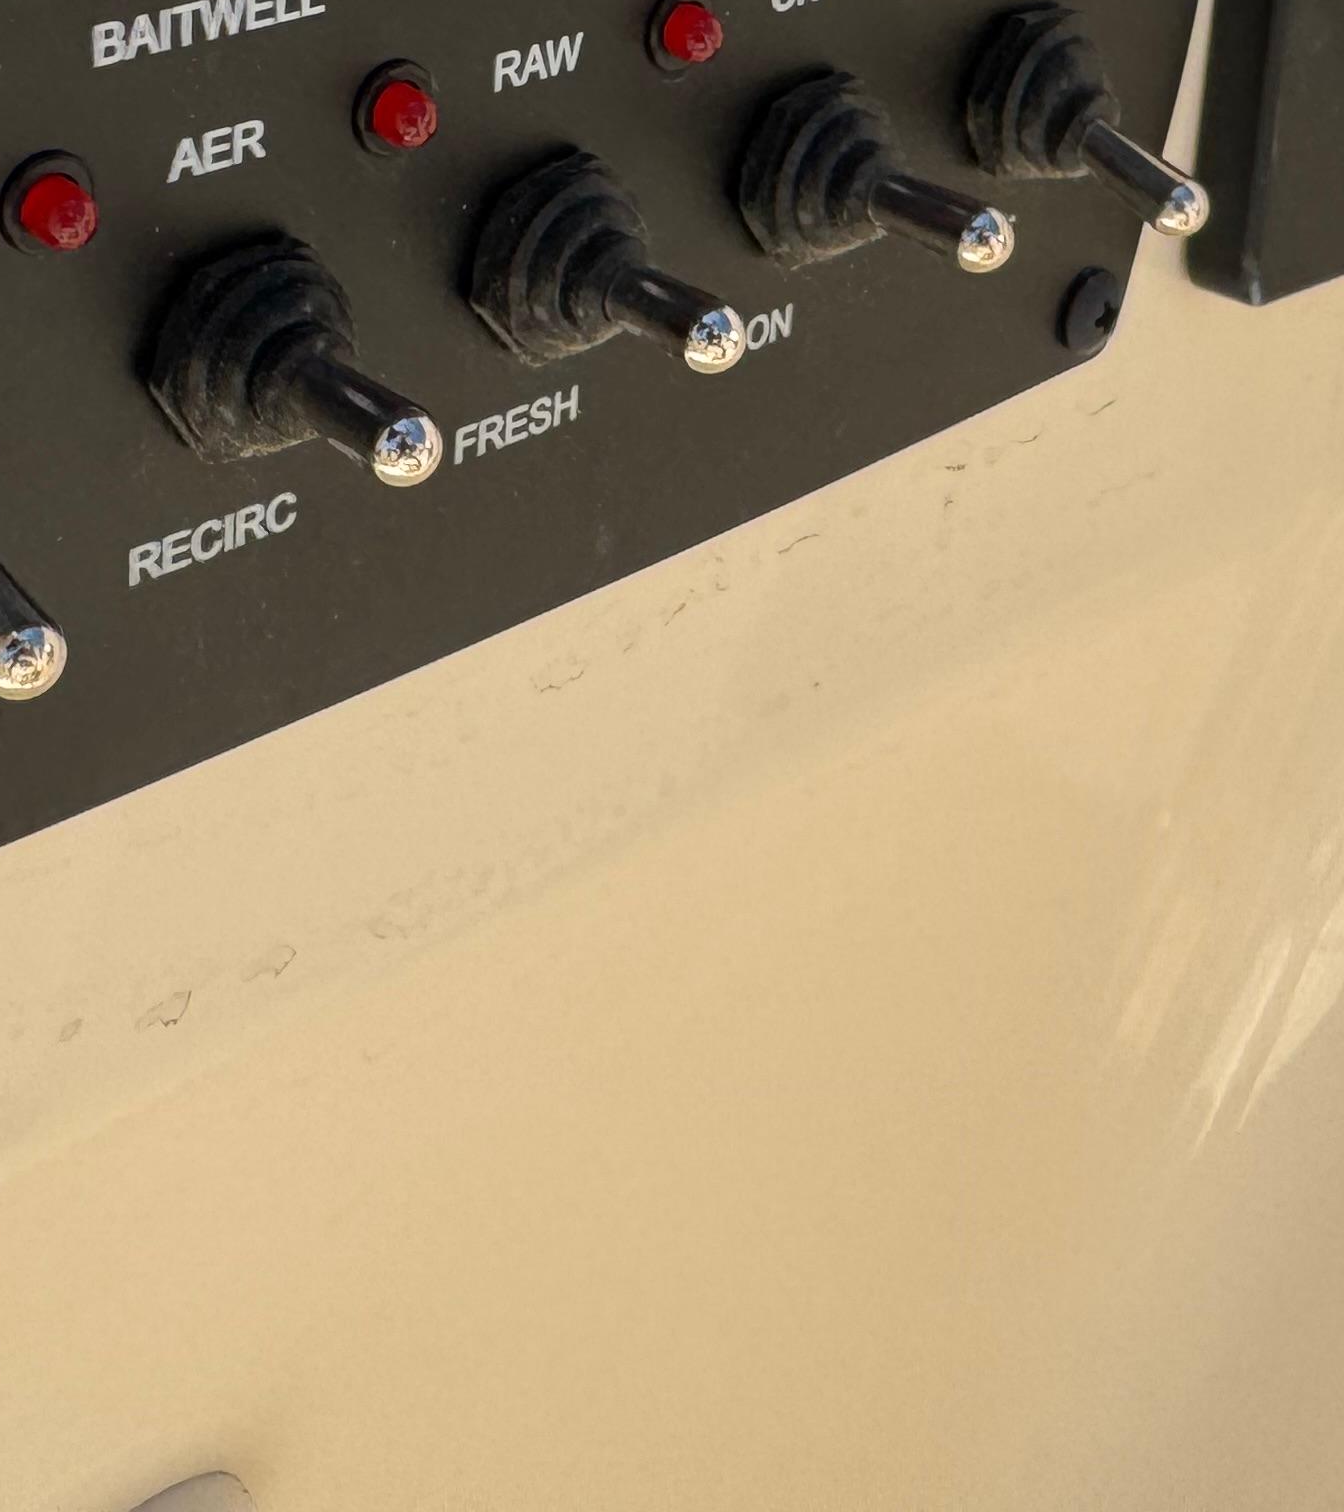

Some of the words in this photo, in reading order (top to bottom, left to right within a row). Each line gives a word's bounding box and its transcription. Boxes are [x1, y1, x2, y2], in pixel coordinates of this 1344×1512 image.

[493, 31, 584, 93] RAW
[166, 119, 267, 184] AER
[746, 302, 794, 351] ON
[454, 384, 579, 465] FRESH
[128, 491, 298, 587] RECIRC
